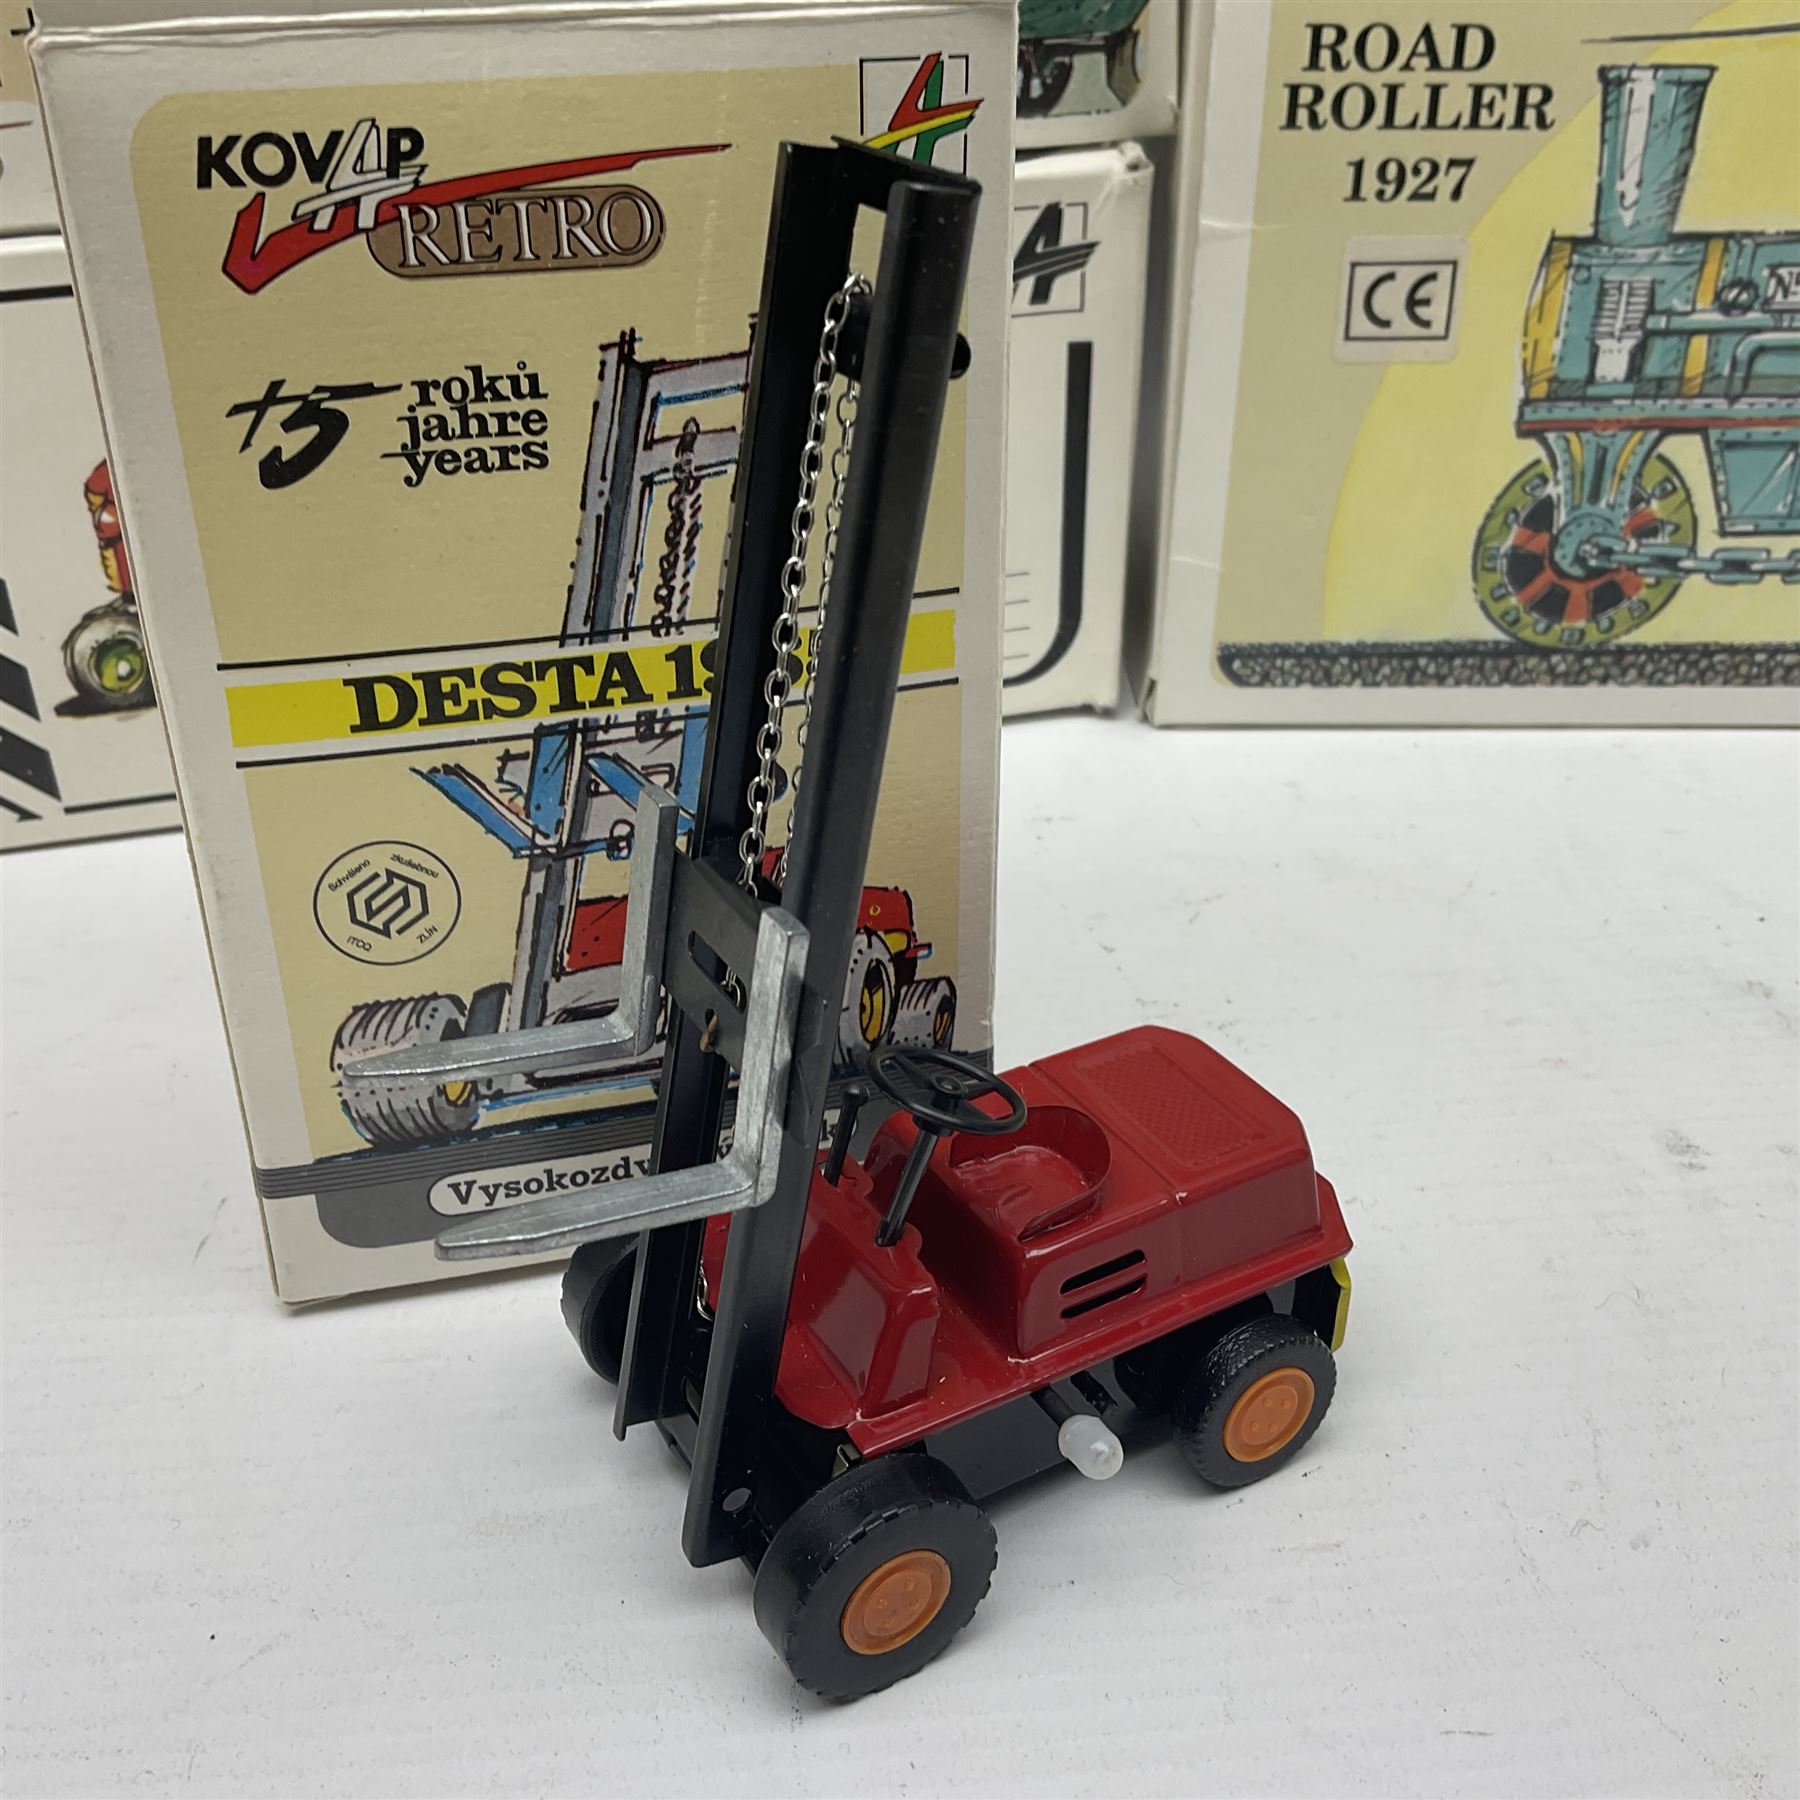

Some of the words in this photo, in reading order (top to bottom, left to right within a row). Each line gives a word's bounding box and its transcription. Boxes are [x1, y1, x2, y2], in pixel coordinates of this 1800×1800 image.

[1301, 22, 1496, 72] ROAD
[1278, 82, 1556, 131] ROLLER
[196, 117, 428, 233] KOVAP
[1342, 155, 1477, 202] 1927
[393, 191, 656, 268] RETRO
[1363, 271, 1438, 329] CE
[410, 360, 549, 407] roků
[396, 403, 548, 452] jahre
[380, 440, 549, 488] years
[342, 651, 654, 735] DESTA
